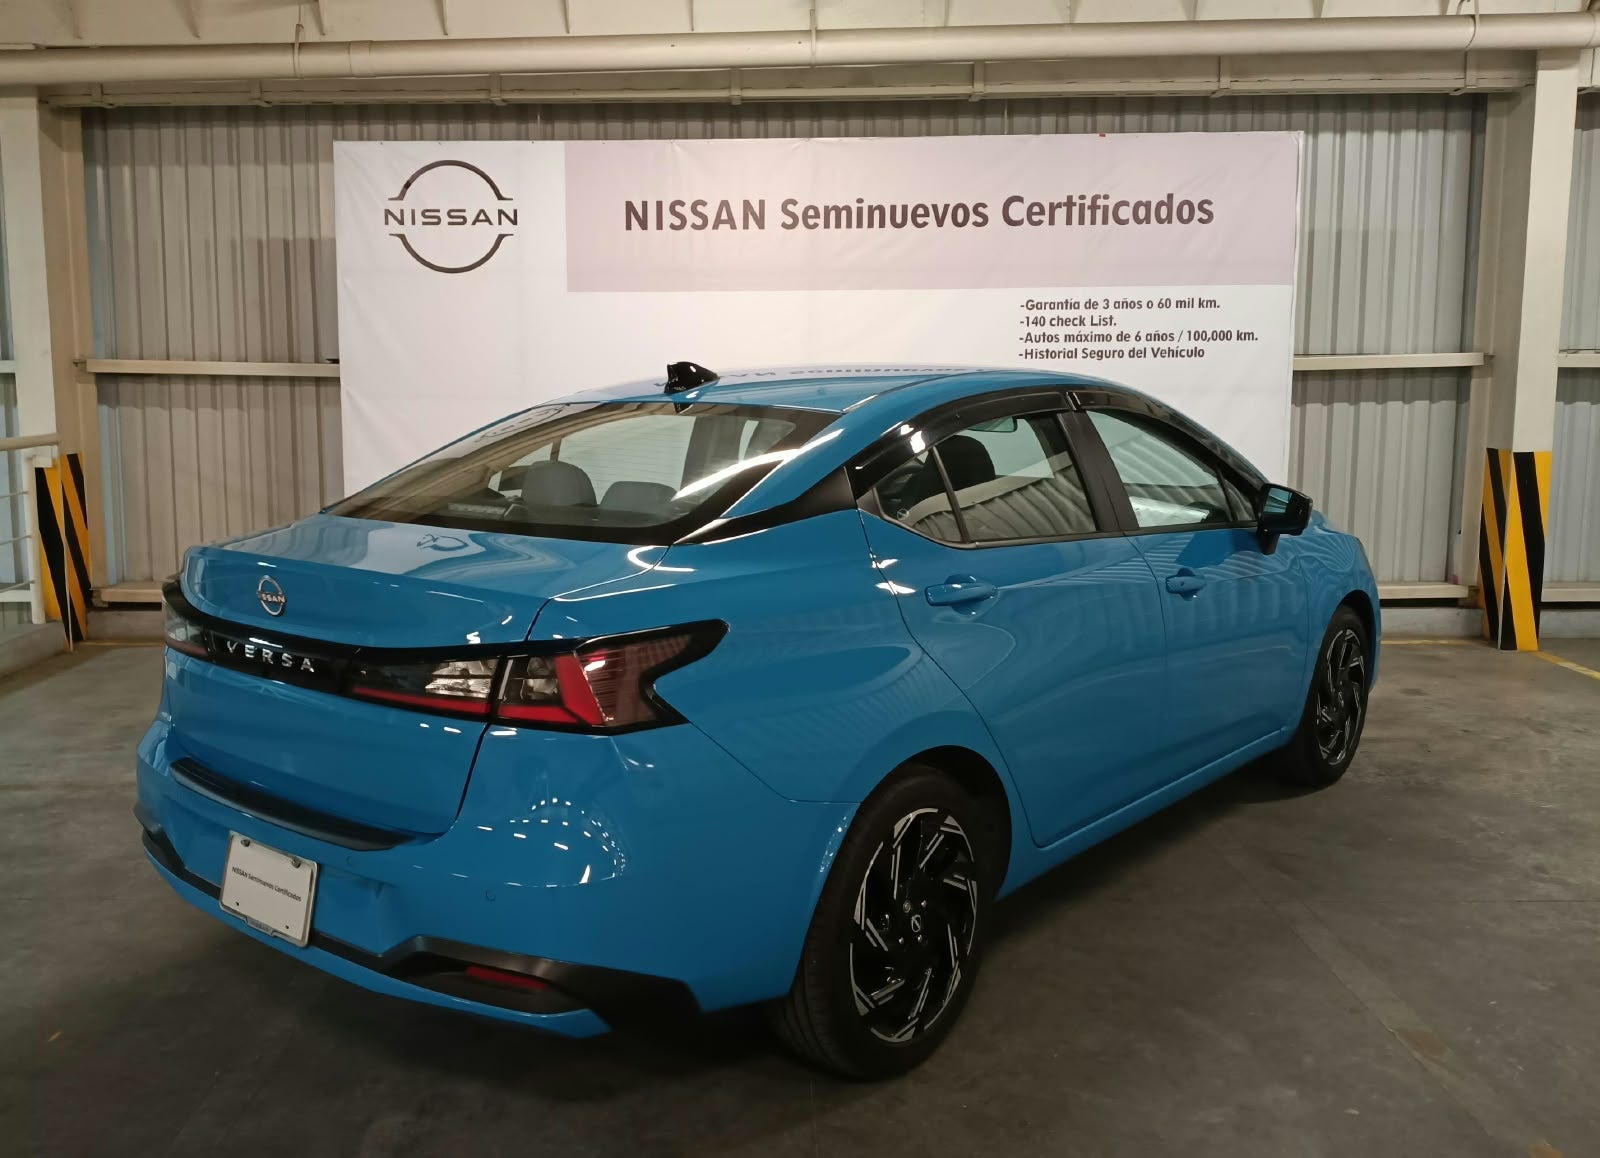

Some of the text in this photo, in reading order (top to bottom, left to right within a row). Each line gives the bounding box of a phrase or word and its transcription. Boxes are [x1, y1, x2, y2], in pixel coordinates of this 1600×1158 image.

[384, 208, 518, 226] NISSAN
[624, 192, 1215, 231] NISSAN Seminuevos Certificados
[1020, 298, 1221, 311] -Garantía de 3 años o 60 mil km.
[1019, 315, 1117, 327] -140 check List.
[1019, 330, 1259, 343] -Autos máximo de 6 años / 100,000 km.
[1018, 346, 1205, 361] -Historial Seguro del Vehículo
[226, 640, 315, 673] VERSA
